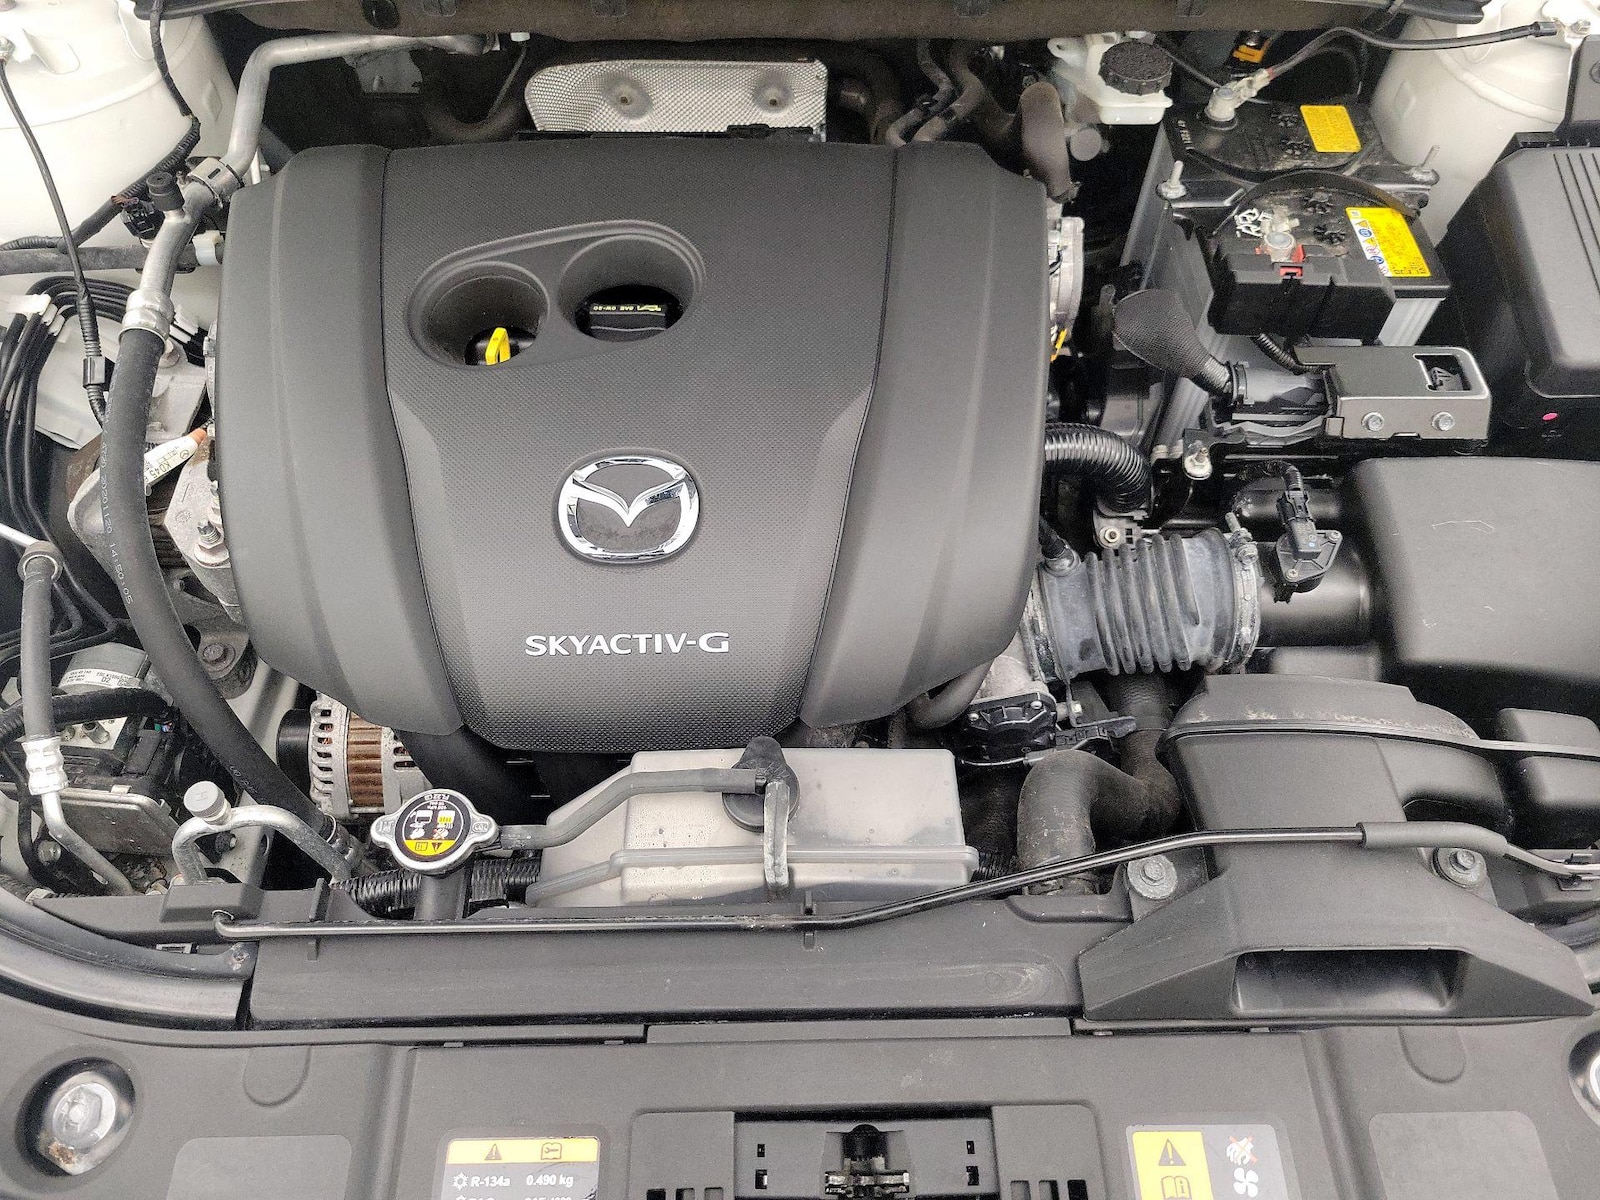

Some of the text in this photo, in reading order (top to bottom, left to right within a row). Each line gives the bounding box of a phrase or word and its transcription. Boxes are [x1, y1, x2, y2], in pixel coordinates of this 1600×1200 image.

[524, 632, 730, 656] SKYACTIV-G
[470, 1173, 574, 1188] R-134a 0.490 kg
